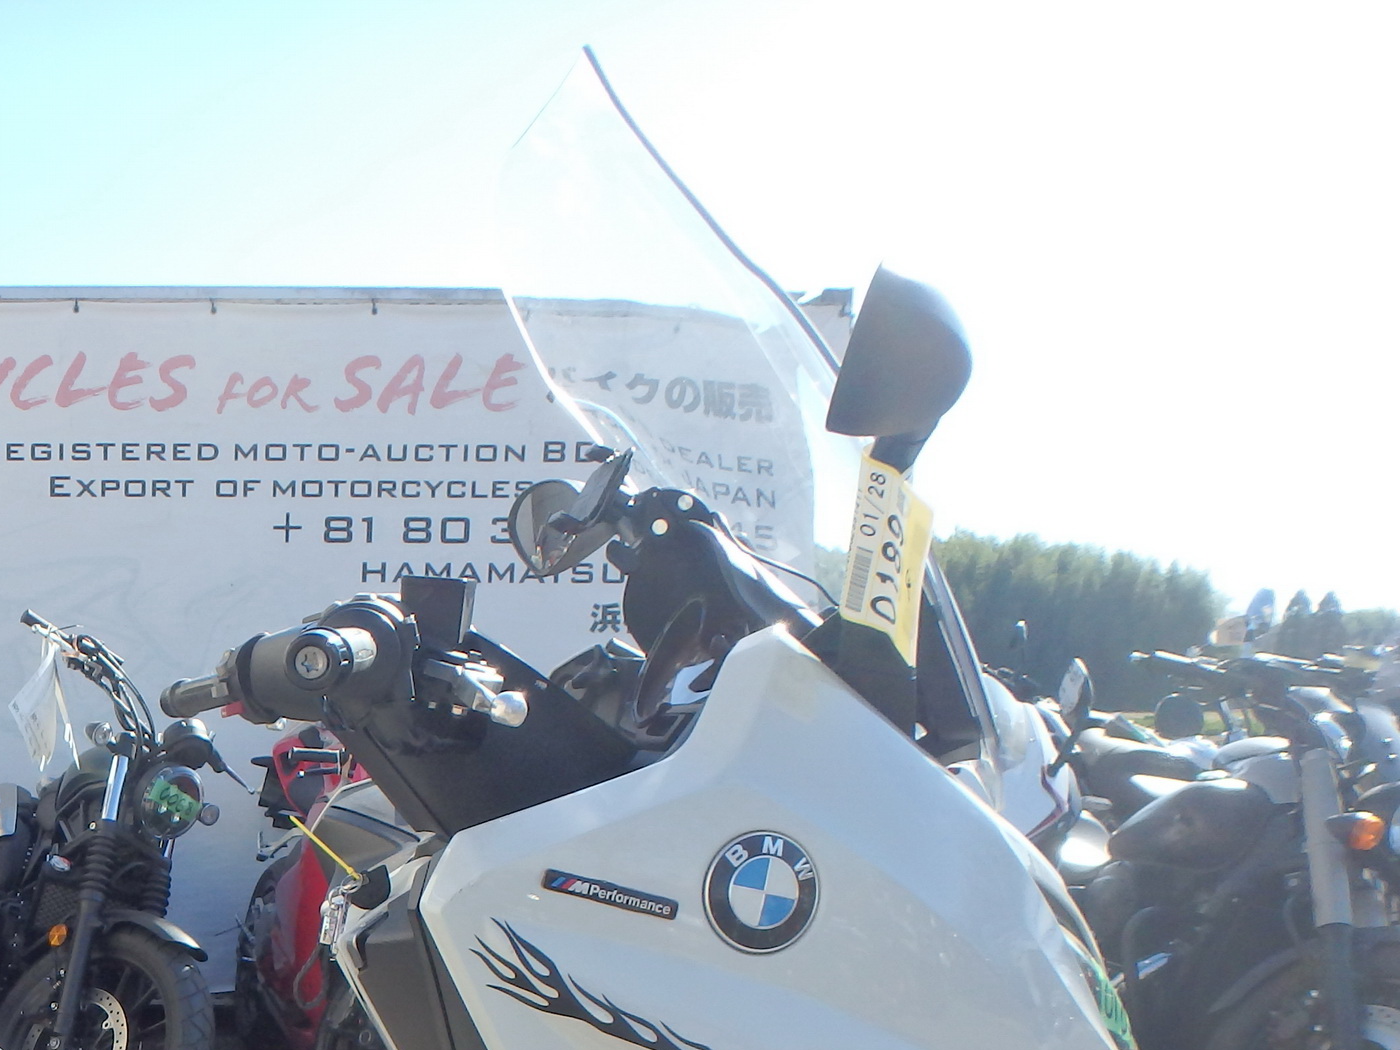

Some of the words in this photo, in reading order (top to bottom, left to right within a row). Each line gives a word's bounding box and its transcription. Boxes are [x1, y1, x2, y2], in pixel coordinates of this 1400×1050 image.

[333, 353, 529, 416] SALE
[233, 442, 527, 463] MOTO-AUCTION
[214, 479, 262, 498] OF
[272, 479, 535, 499] MOTORCYCLES
[859, 471, 887, 538] 01/28
[322, 515, 375, 544] 81
[402, 516, 471, 545] 80
[724, 835, 814, 882] BMW
[588, 883, 672, 916] Performance
